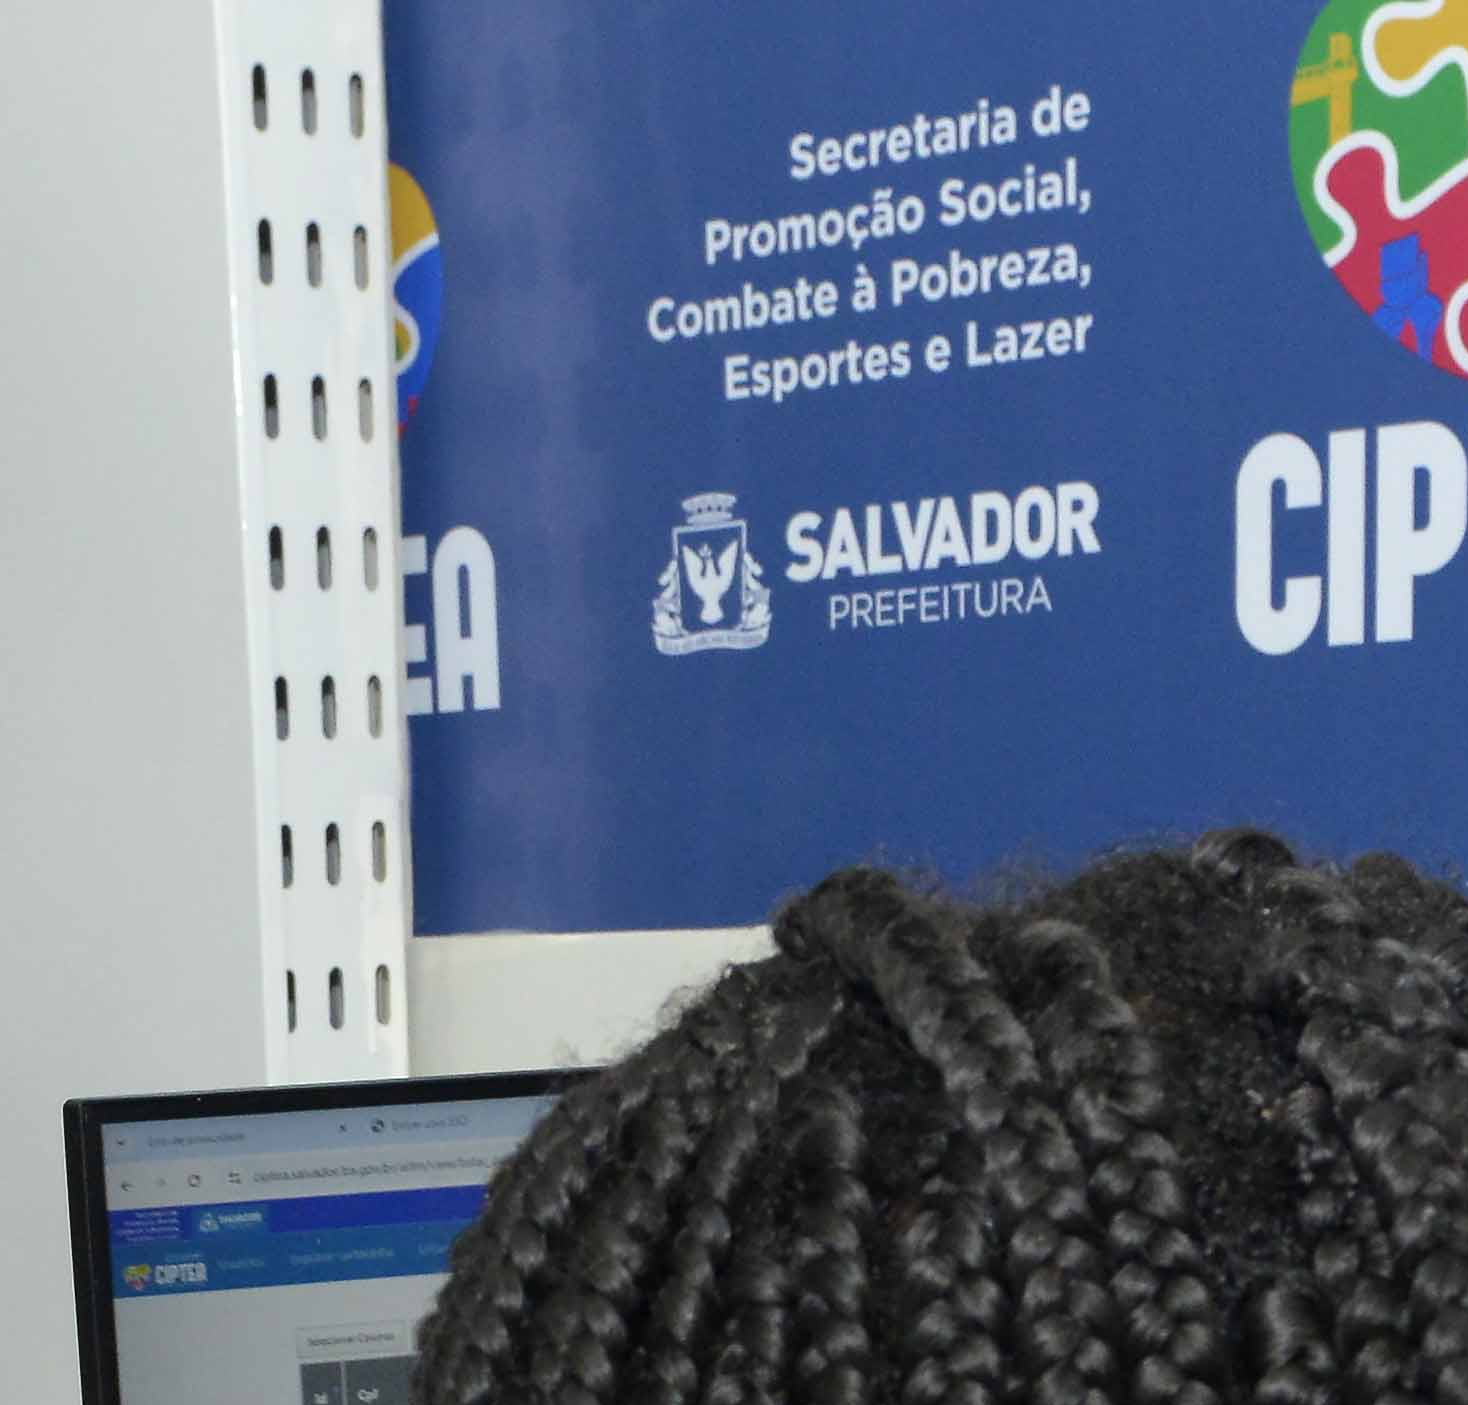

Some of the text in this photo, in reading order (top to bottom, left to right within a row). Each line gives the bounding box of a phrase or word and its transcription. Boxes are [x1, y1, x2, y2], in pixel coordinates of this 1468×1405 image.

[790, 85, 1091, 180] Secretaria de
[704, 159, 1092, 266] Promoção Social,
[647, 242, 1092, 343] Combate à Pobreza,
[724, 313, 1093, 403] Esportes e Lazer
[785, 481, 1102, 583] SALVADOR
[829, 576, 1053, 631] PREFEITURA
